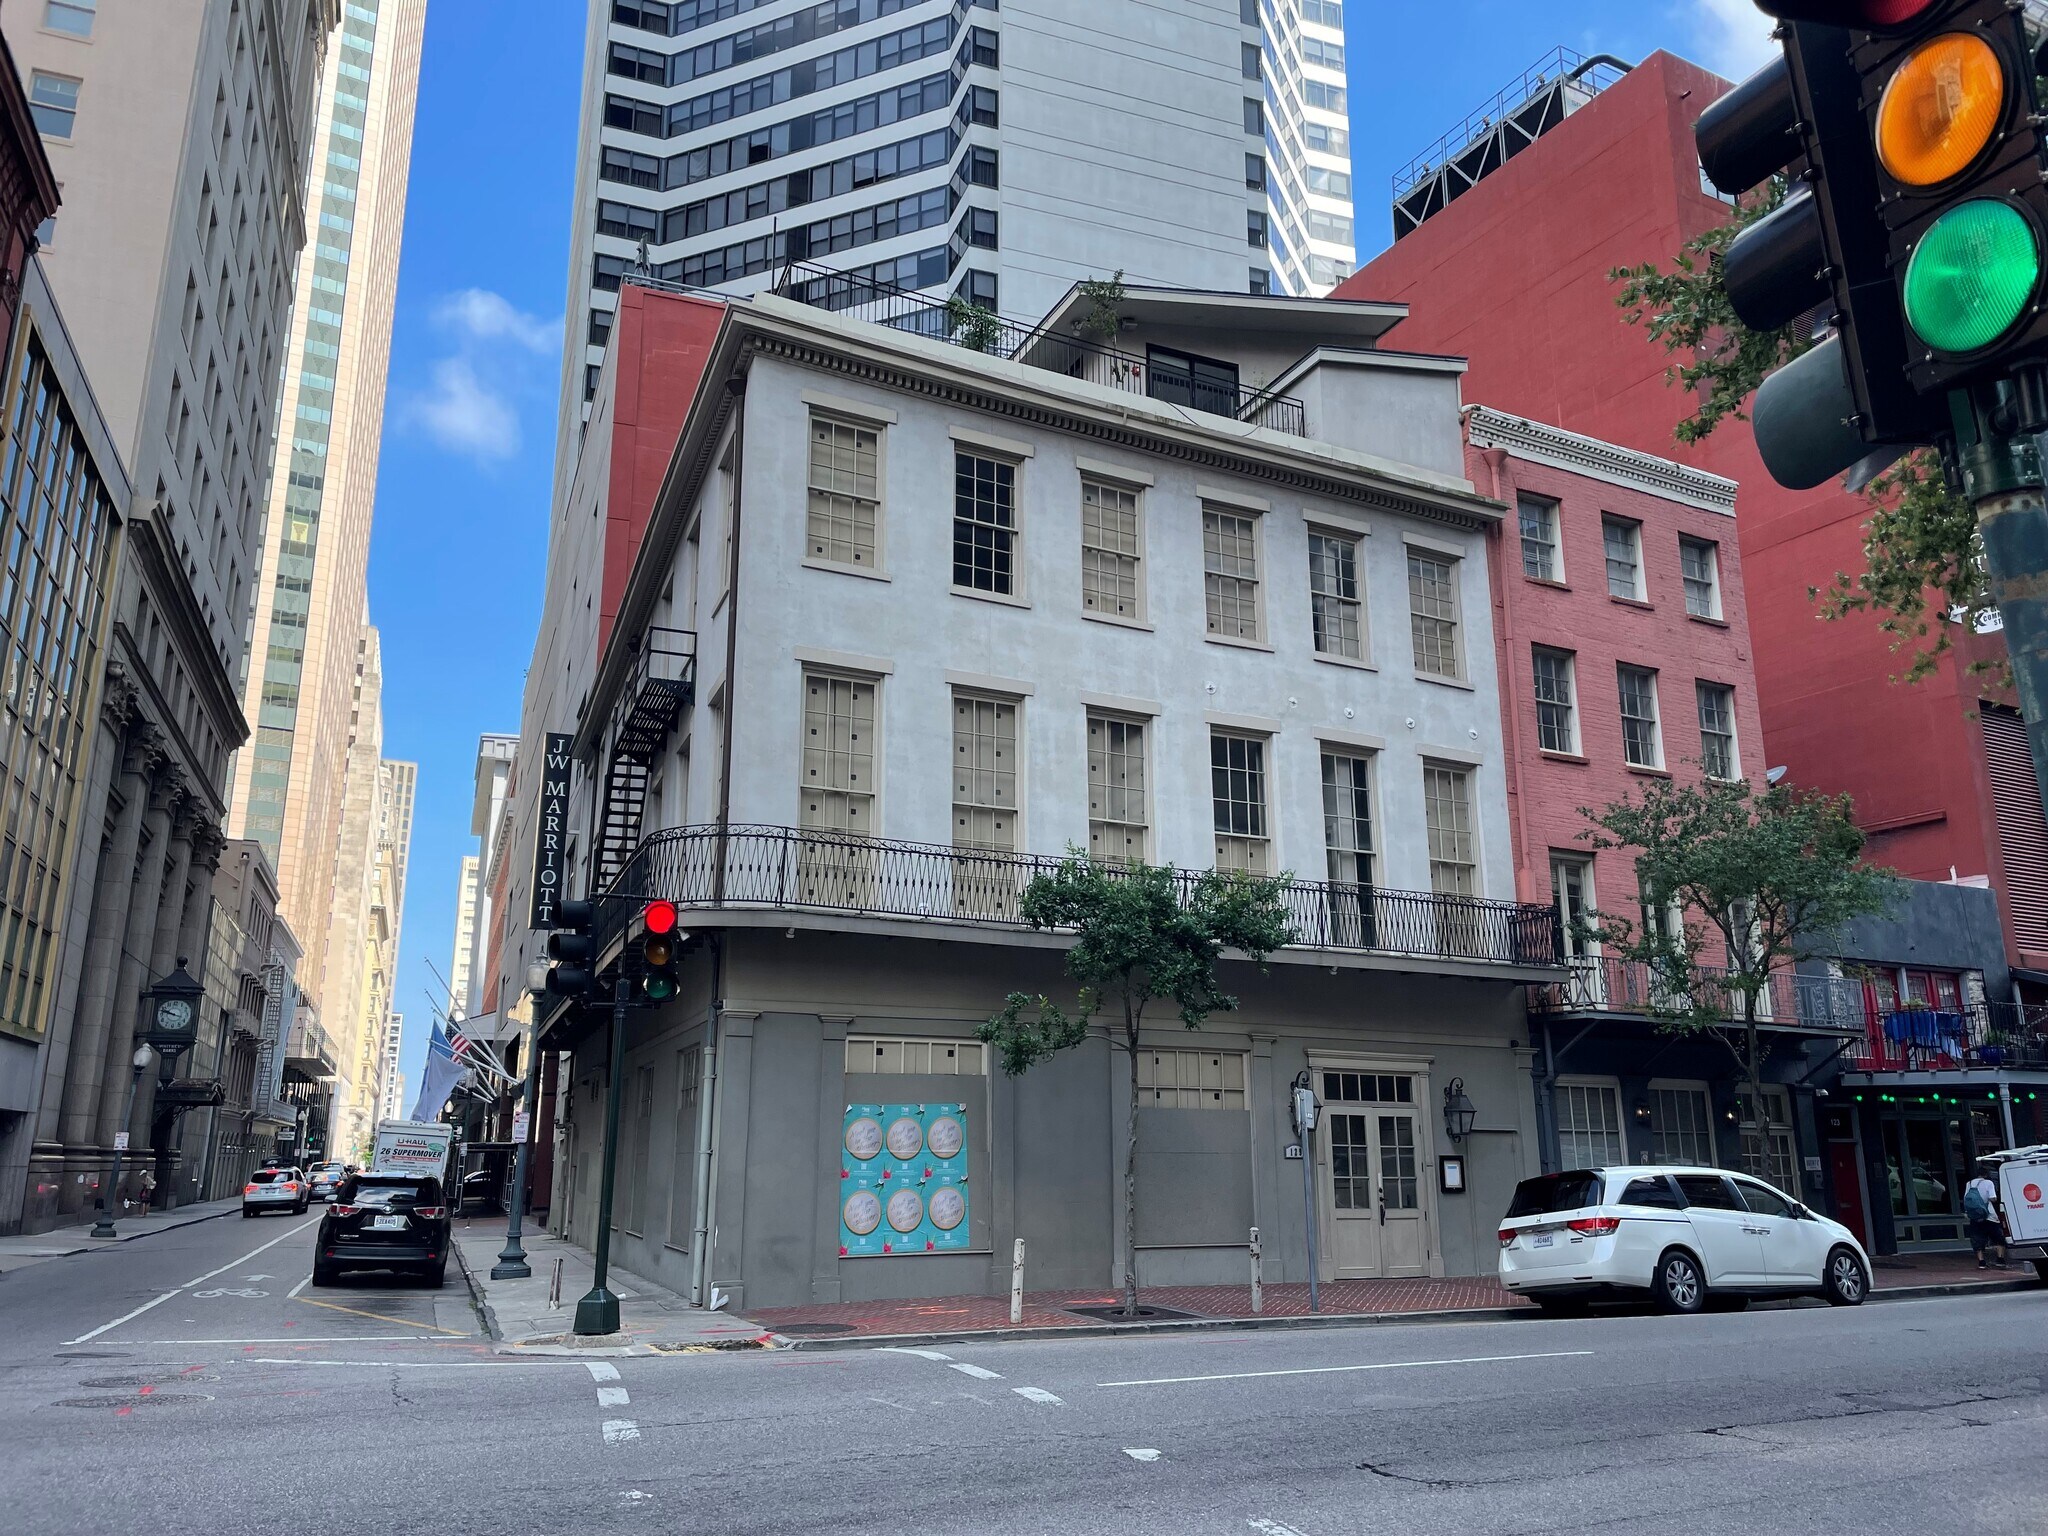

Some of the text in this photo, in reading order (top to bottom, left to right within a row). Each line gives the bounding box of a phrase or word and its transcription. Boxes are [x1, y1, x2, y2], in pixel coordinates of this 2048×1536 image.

[539, 739, 570, 922] JW MARRIOTT
[397, 1138, 427, 1146] U-HAUL
[392, 1148, 443, 1158] SUPERMOVER
